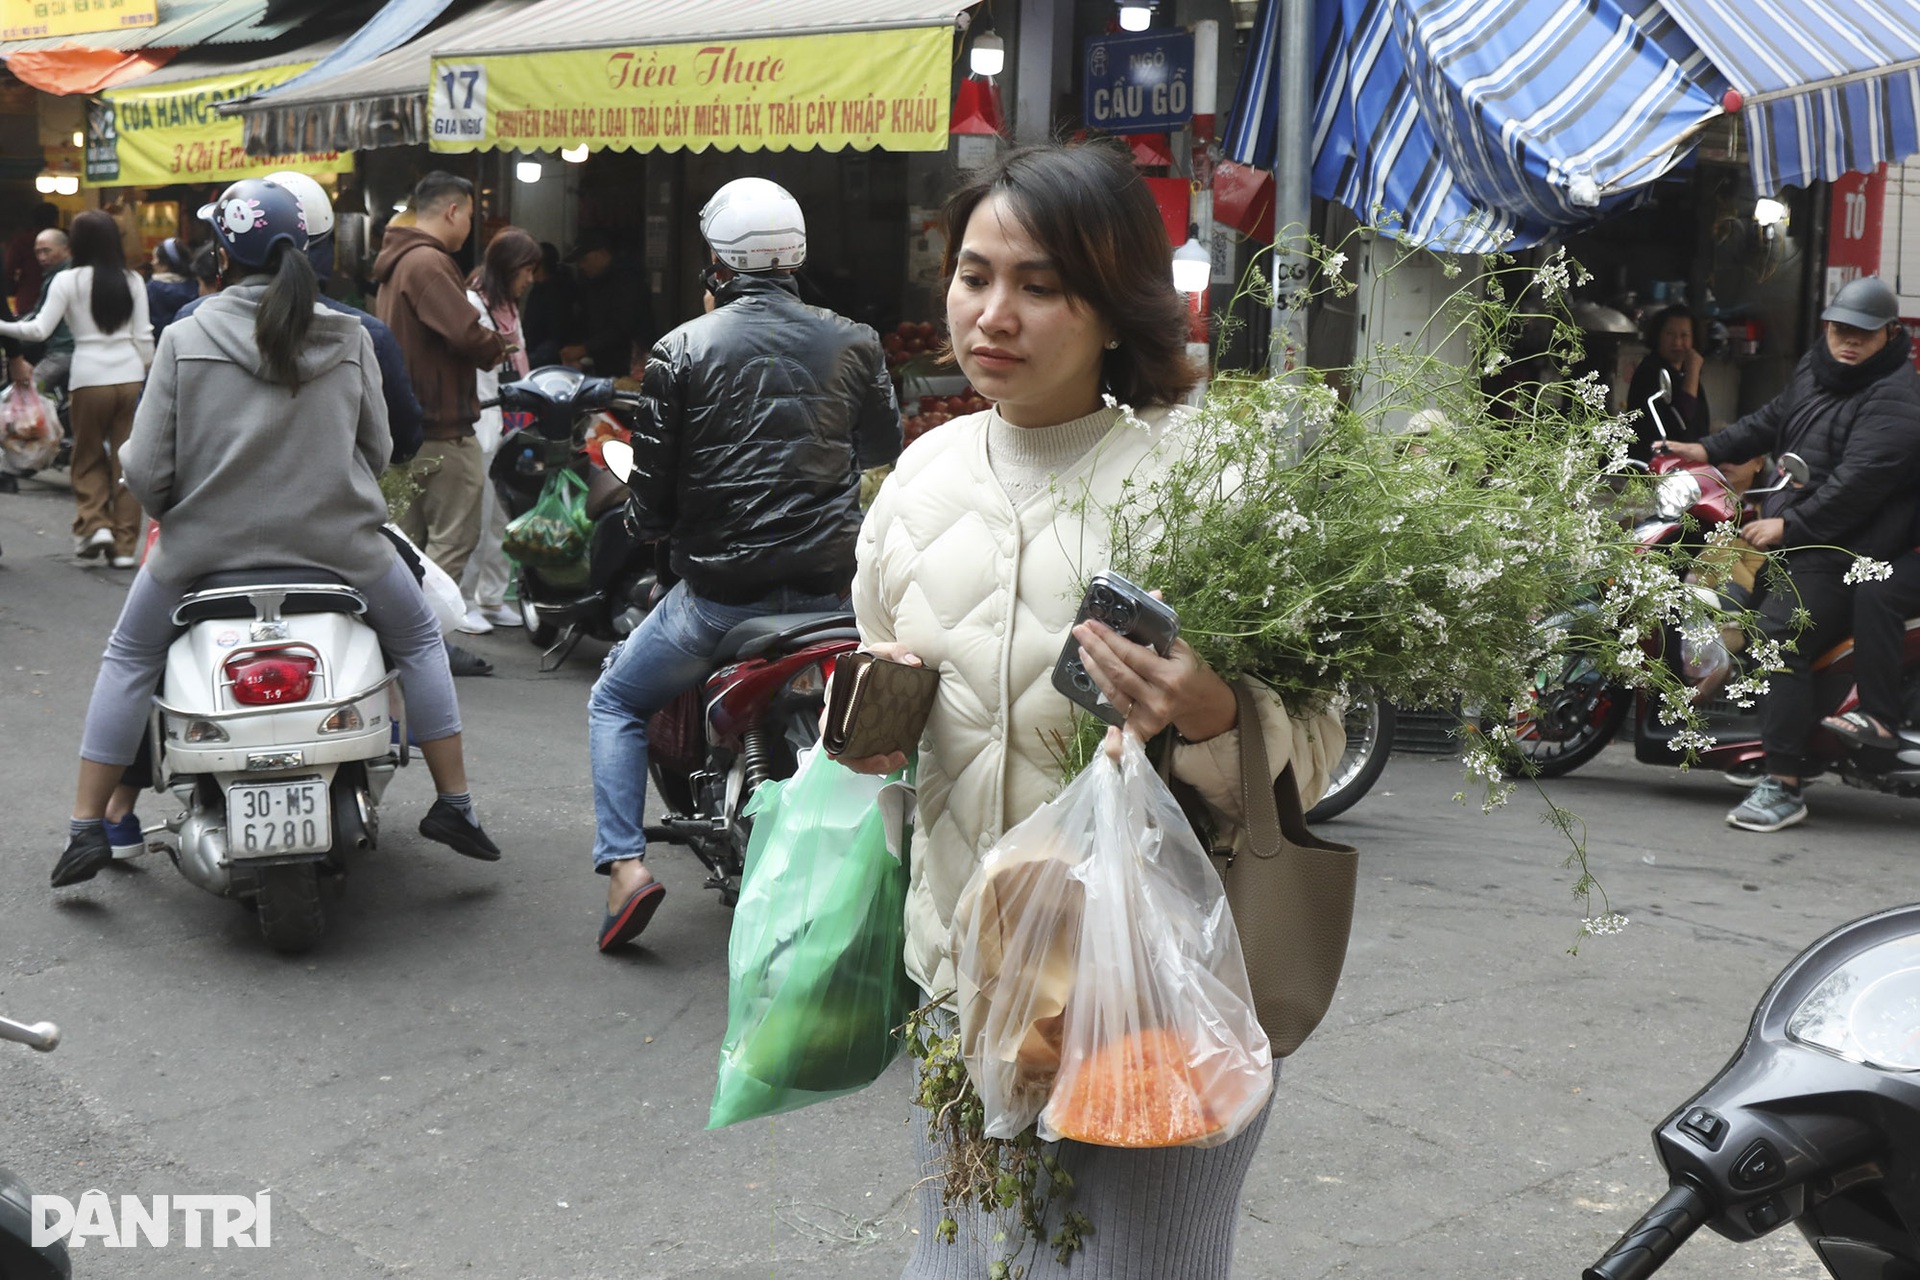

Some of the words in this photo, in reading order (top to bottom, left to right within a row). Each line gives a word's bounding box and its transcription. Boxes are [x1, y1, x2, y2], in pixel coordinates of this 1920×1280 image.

[605, 50, 679, 90] Tiền
[693, 46, 786, 91] Thực
[441, 70, 480, 110] 17
[1094, 76, 1143, 120] CẦU
[1152, 67, 1187, 115] GỖ
[434, 117, 457, 135] GIA
[543, 102, 569, 138] BÁN
[571, 101, 596, 137] CÁC
[599, 106, 627, 142] LOẠI
[631, 99, 660, 137] TRÁI
[664, 98, 691, 137] CÂY
[768, 94, 801, 135] TRÁI
[806, 93, 837, 135] CÂY
[841, 92, 887, 142] NHẬP
[170, 143, 184, 174] 3
[243, 786, 315, 819] 30-M5
[244, 819, 316, 852] 6280
